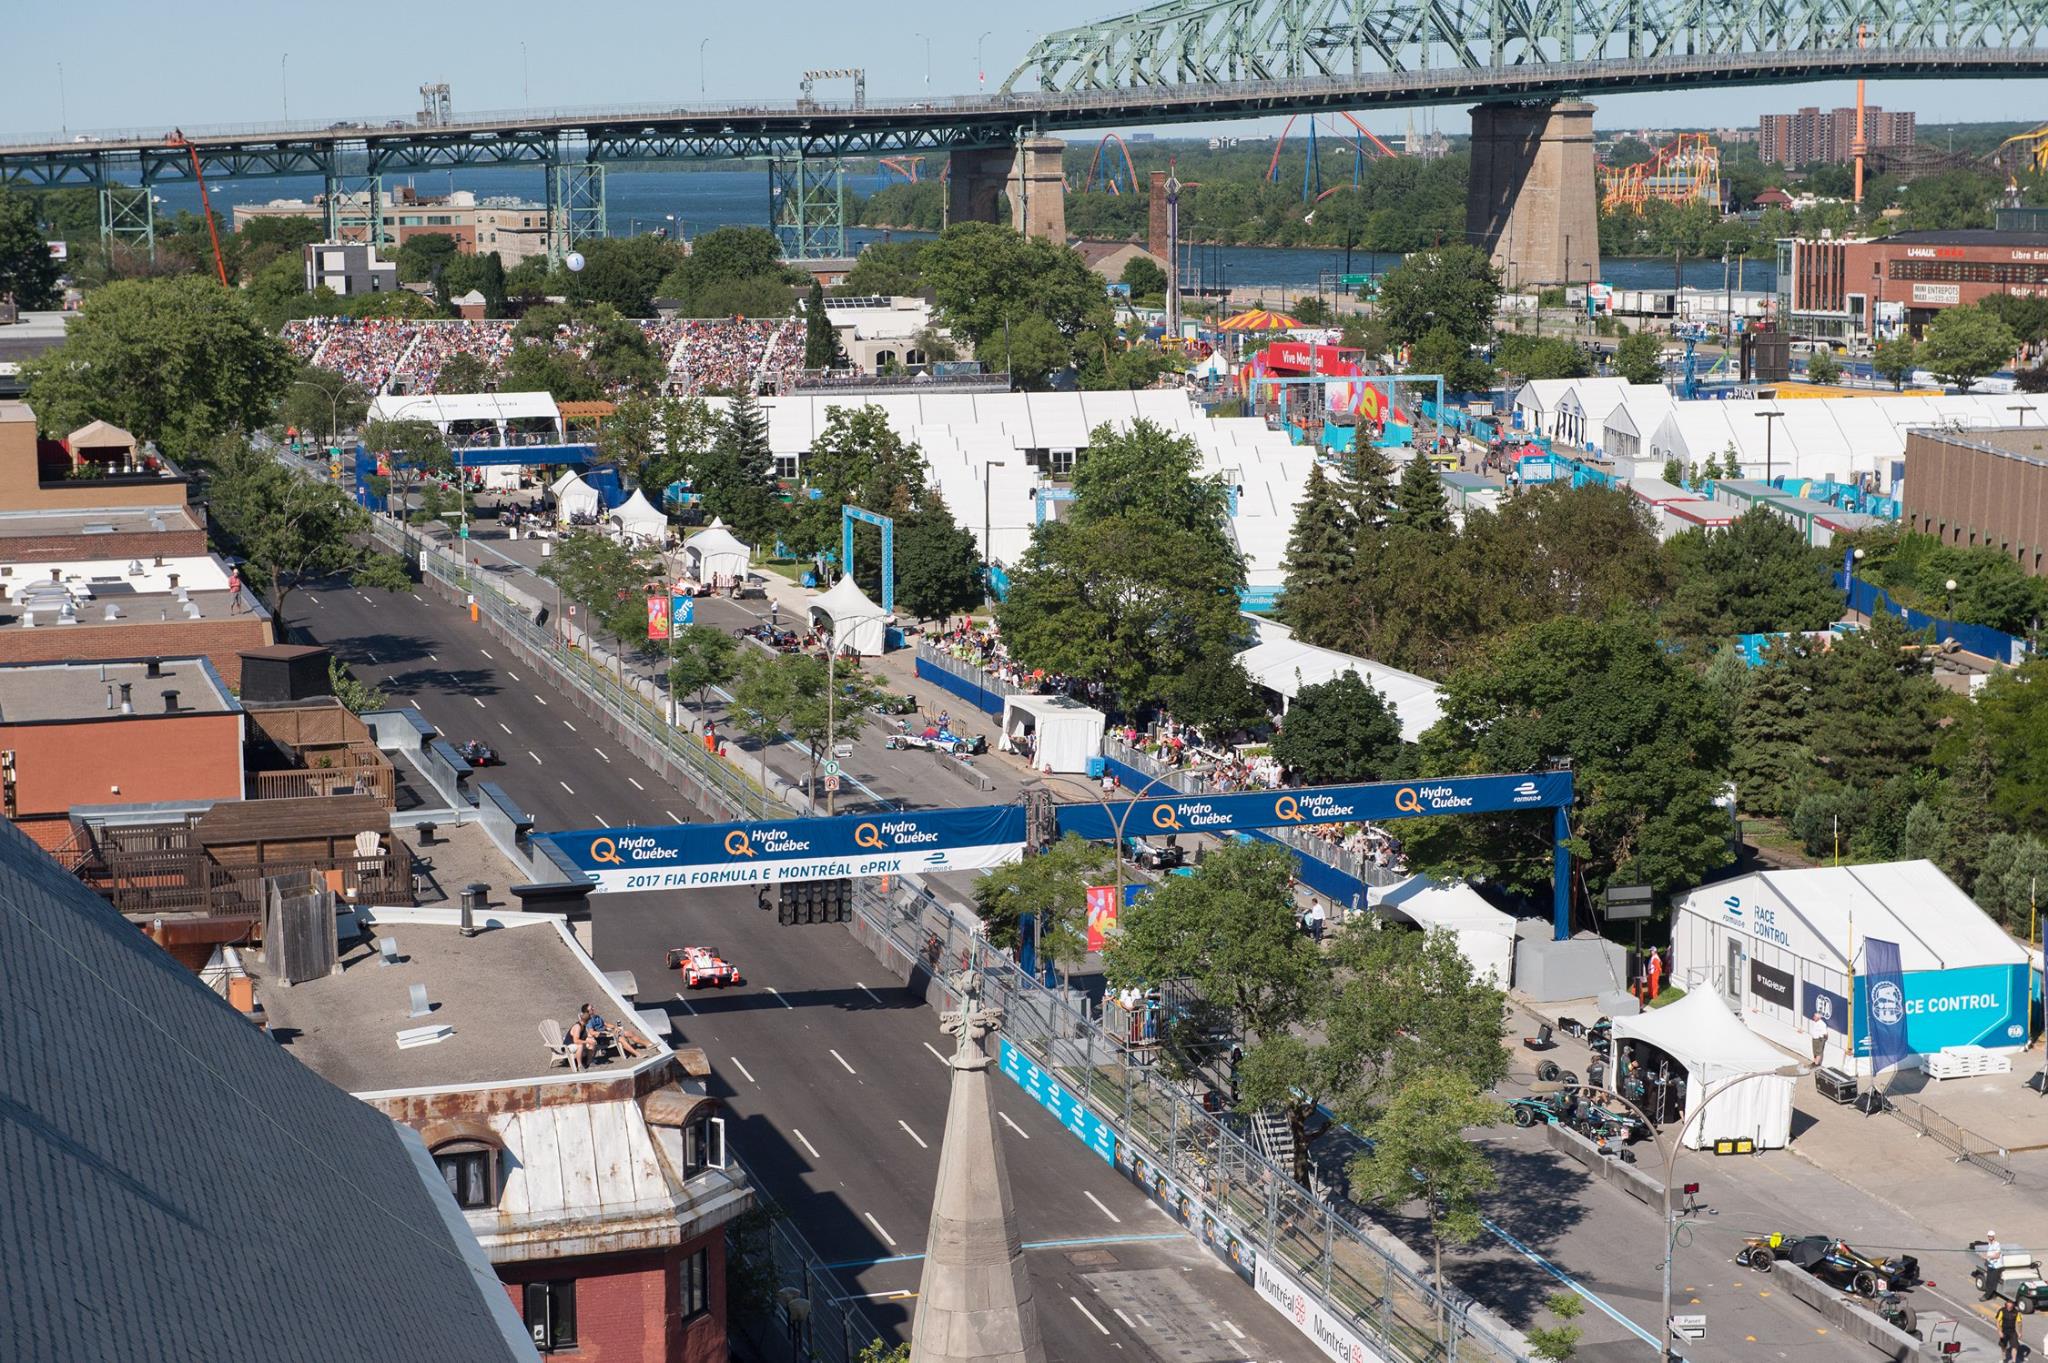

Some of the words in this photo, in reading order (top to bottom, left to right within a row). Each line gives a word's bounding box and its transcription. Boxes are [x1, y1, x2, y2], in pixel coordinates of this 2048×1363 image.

[2012, 250, 2031, 260] Libre
[1282, 350, 1295, 364] Vive
[1419, 786, 1452, 799] Hydro
[1300, 795, 1333, 808] Hydro
[1431, 796, 1472, 808] Québec
[1178, 803, 1211, 816] Hydro
[1312, 804, 1354, 817] Québec
[1190, 812, 1232, 825] Québec
[881, 821, 916, 835] Hydro
[618, 836, 656, 850] Hydro
[752, 829, 788, 843] Hydro
[894, 830, 938, 844] Québec
[764, 839, 810, 852] Québec
[632, 846, 678, 860] Québec
[626, 875, 660, 888] 2017
[664, 873, 687, 886] FIA
[691, 869, 757, 884] FORMULA
[763, 868, 771, 879] E
[778, 862, 852, 878] MONTRÉAL
[860, 859, 901, 874] ePRIX
[1754, 905, 1775, 925] RACE
[1753, 921, 1790, 946] CONTROL
[1905, 999, 1924, 1014] CE
[1928, 994, 2000, 1013] CONTROL
[1259, 1267, 1296, 1313] Montréal
[1313, 1314, 1352, 1363] Montréal
